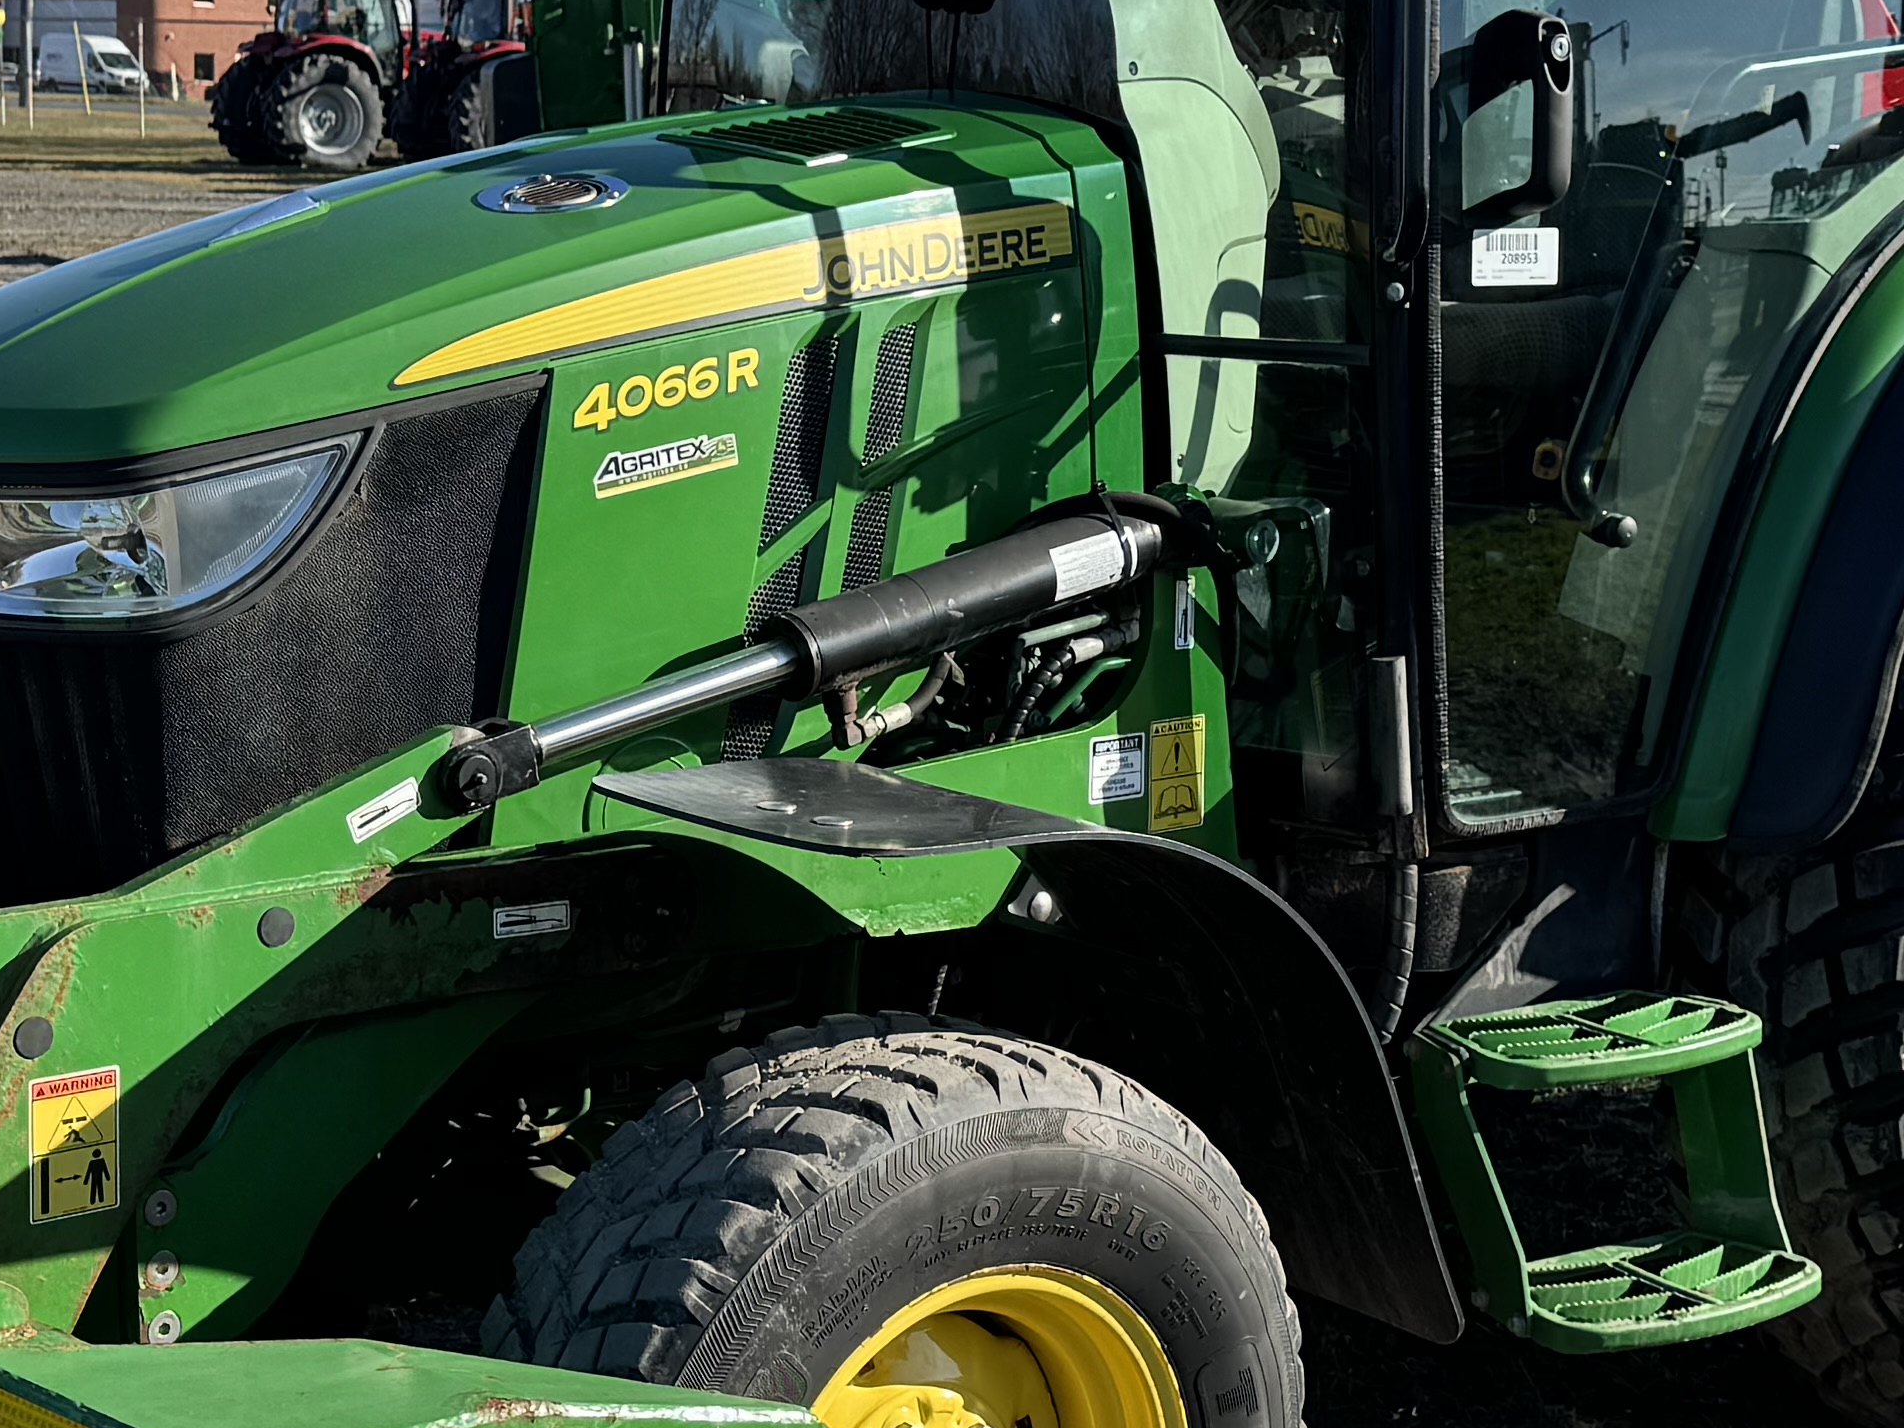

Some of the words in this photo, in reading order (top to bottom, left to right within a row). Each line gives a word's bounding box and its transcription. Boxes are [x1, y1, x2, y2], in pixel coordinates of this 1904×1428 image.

[802, 243, 916, 295] JOHN
[922, 224, 1046, 274] DEERE
[1501, 252, 1539, 265] 208953
[597, 439, 707, 481] AGRITEX
[1160, 720, 1201, 733] CAUTION
[48, 1074, 114, 1095] WARNING
[1116, 1129, 1222, 1212] ROTATION
[904, 1186, 1173, 1258] 250/75R16
